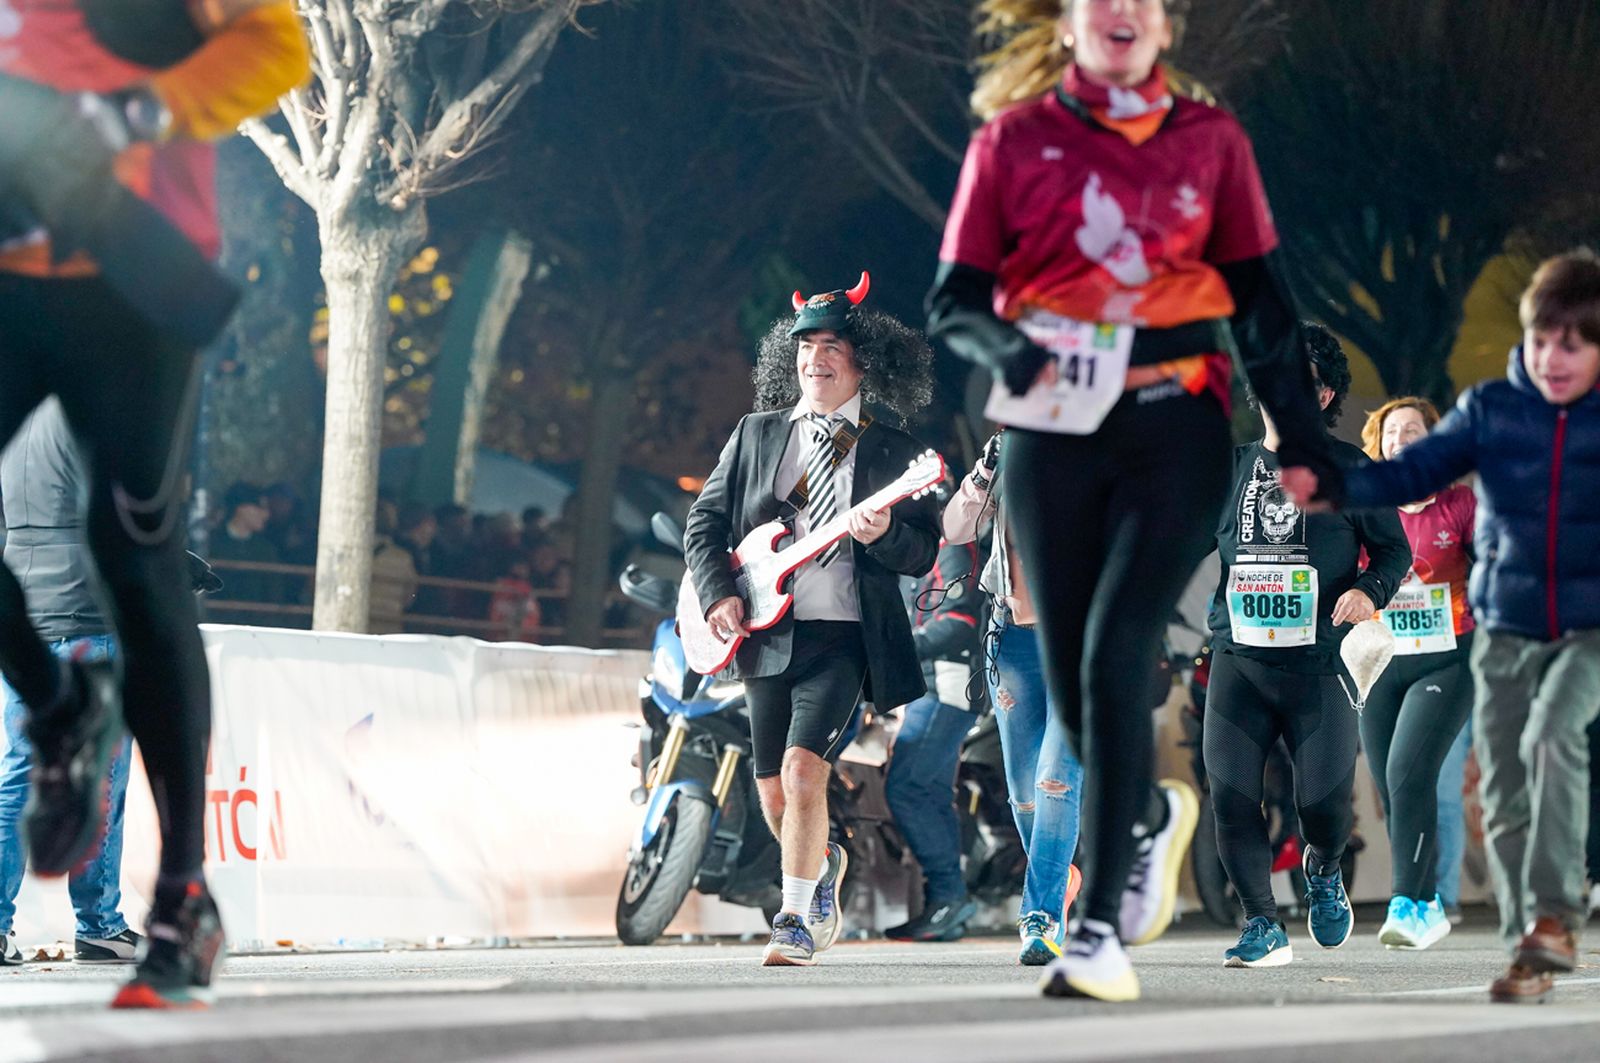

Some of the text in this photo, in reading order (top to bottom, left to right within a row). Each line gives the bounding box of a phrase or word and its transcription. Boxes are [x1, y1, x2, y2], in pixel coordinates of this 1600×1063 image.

[1241, 480, 1260, 543] CREATION
[1236, 584, 1253, 592] SAN
[1246, 574, 1284, 582] NOCHE DE
[1242, 594, 1302, 619] 8085
[1388, 608, 1444, 630] 13855
